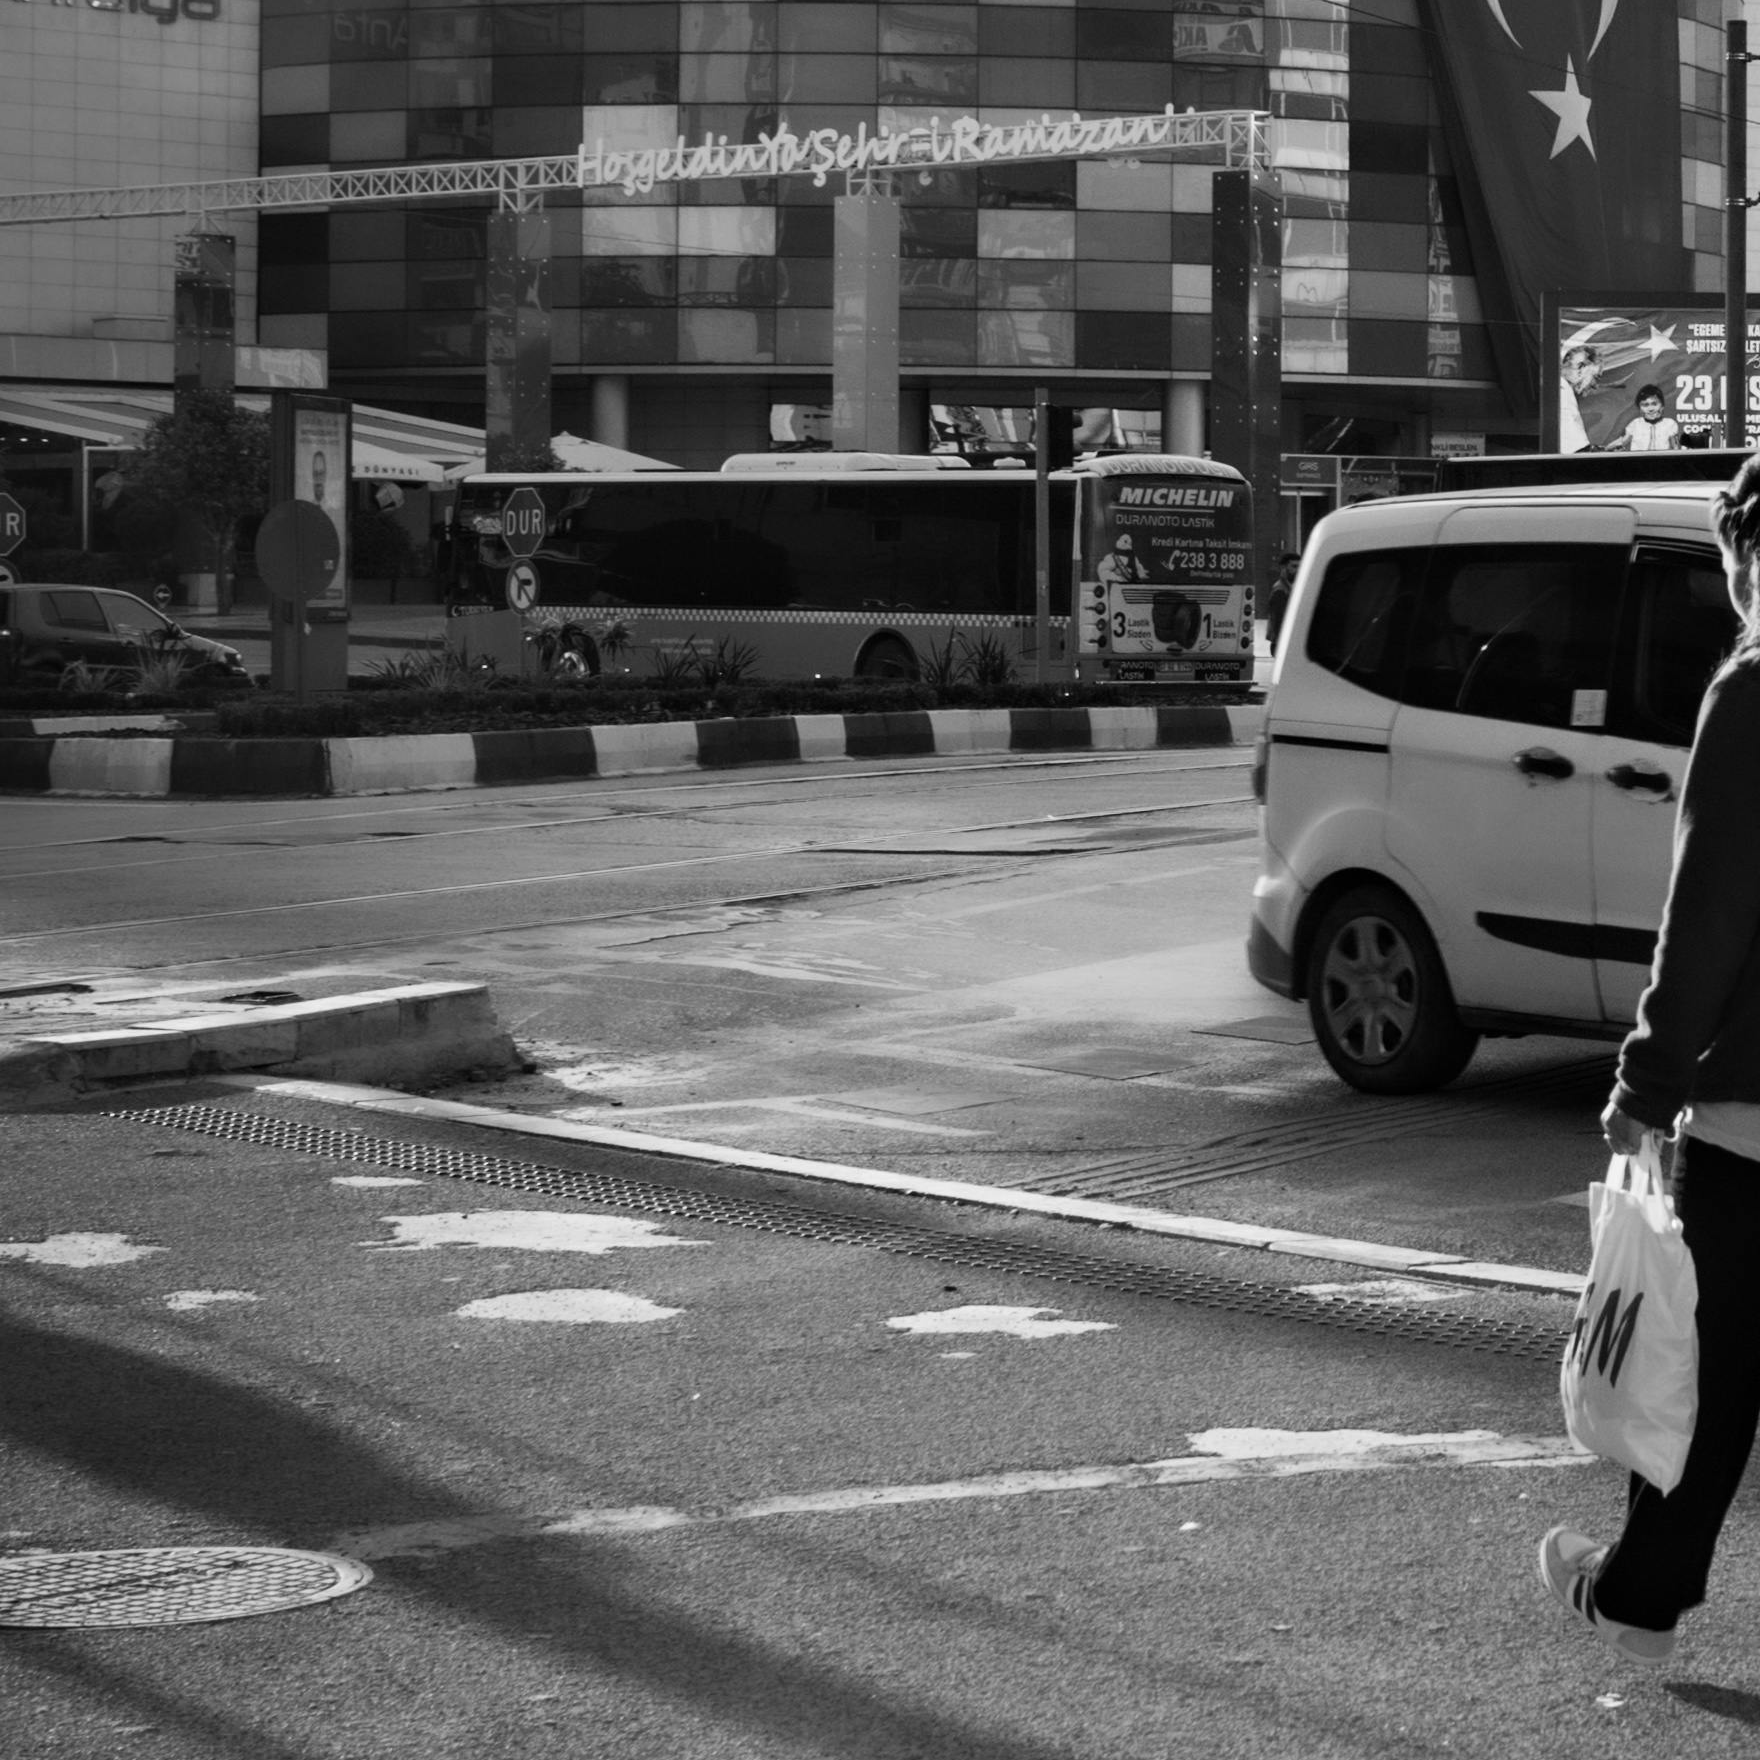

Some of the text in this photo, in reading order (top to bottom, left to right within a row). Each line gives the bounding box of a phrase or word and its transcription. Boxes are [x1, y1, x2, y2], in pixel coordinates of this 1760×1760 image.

[1686, 339, 1727, 354] ŞARTSIZ
[1675, 374, 1713, 410] 23
[1676, 413, 1722, 423] ULUSAL
[1119, 486, 1234, 508] MICHELIN
[506, 510, 542, 535] DUR
[1115, 513, 1180, 527] DURANOTO
[1179, 552, 1245, 570] 238 3 888
[1113, 611, 1126, 638] 3
[1203, 613, 1212, 639] 1
